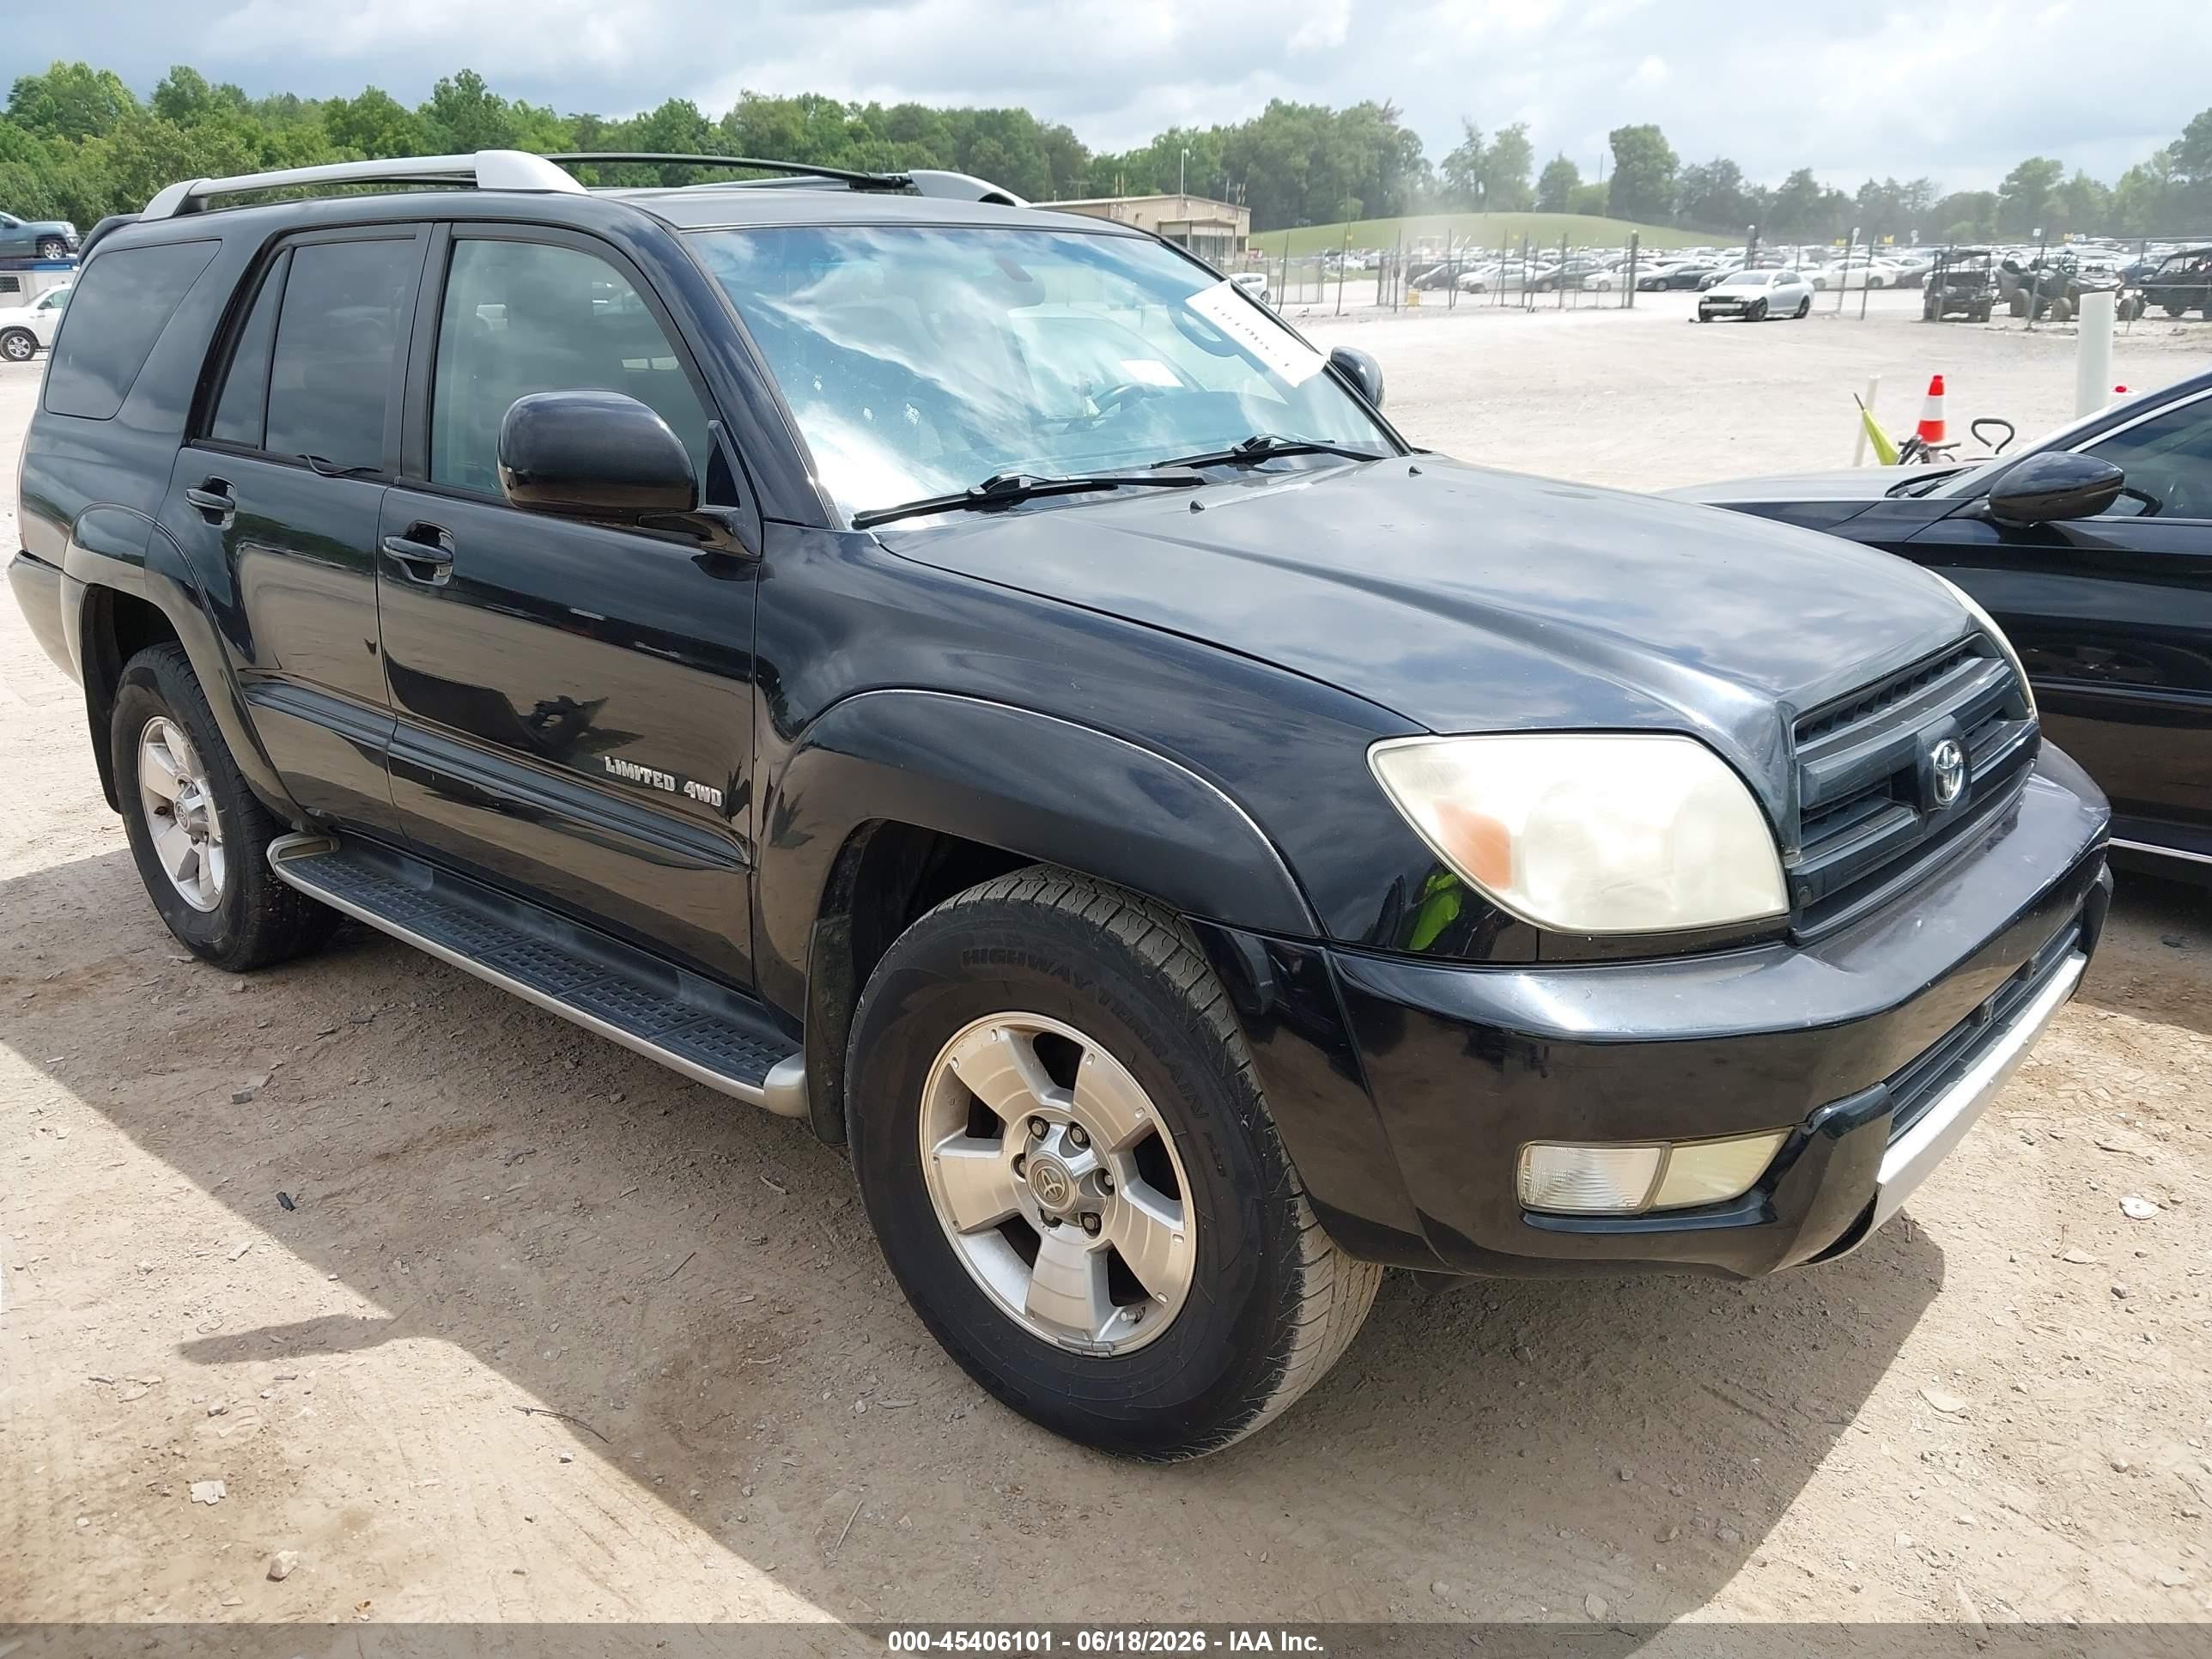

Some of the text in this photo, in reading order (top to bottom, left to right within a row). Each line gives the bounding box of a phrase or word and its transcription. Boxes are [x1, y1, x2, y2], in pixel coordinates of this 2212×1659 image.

[605, 756, 723, 807] LIMITED 4WD
[962, 947, 1094, 990] HIGHWAY
